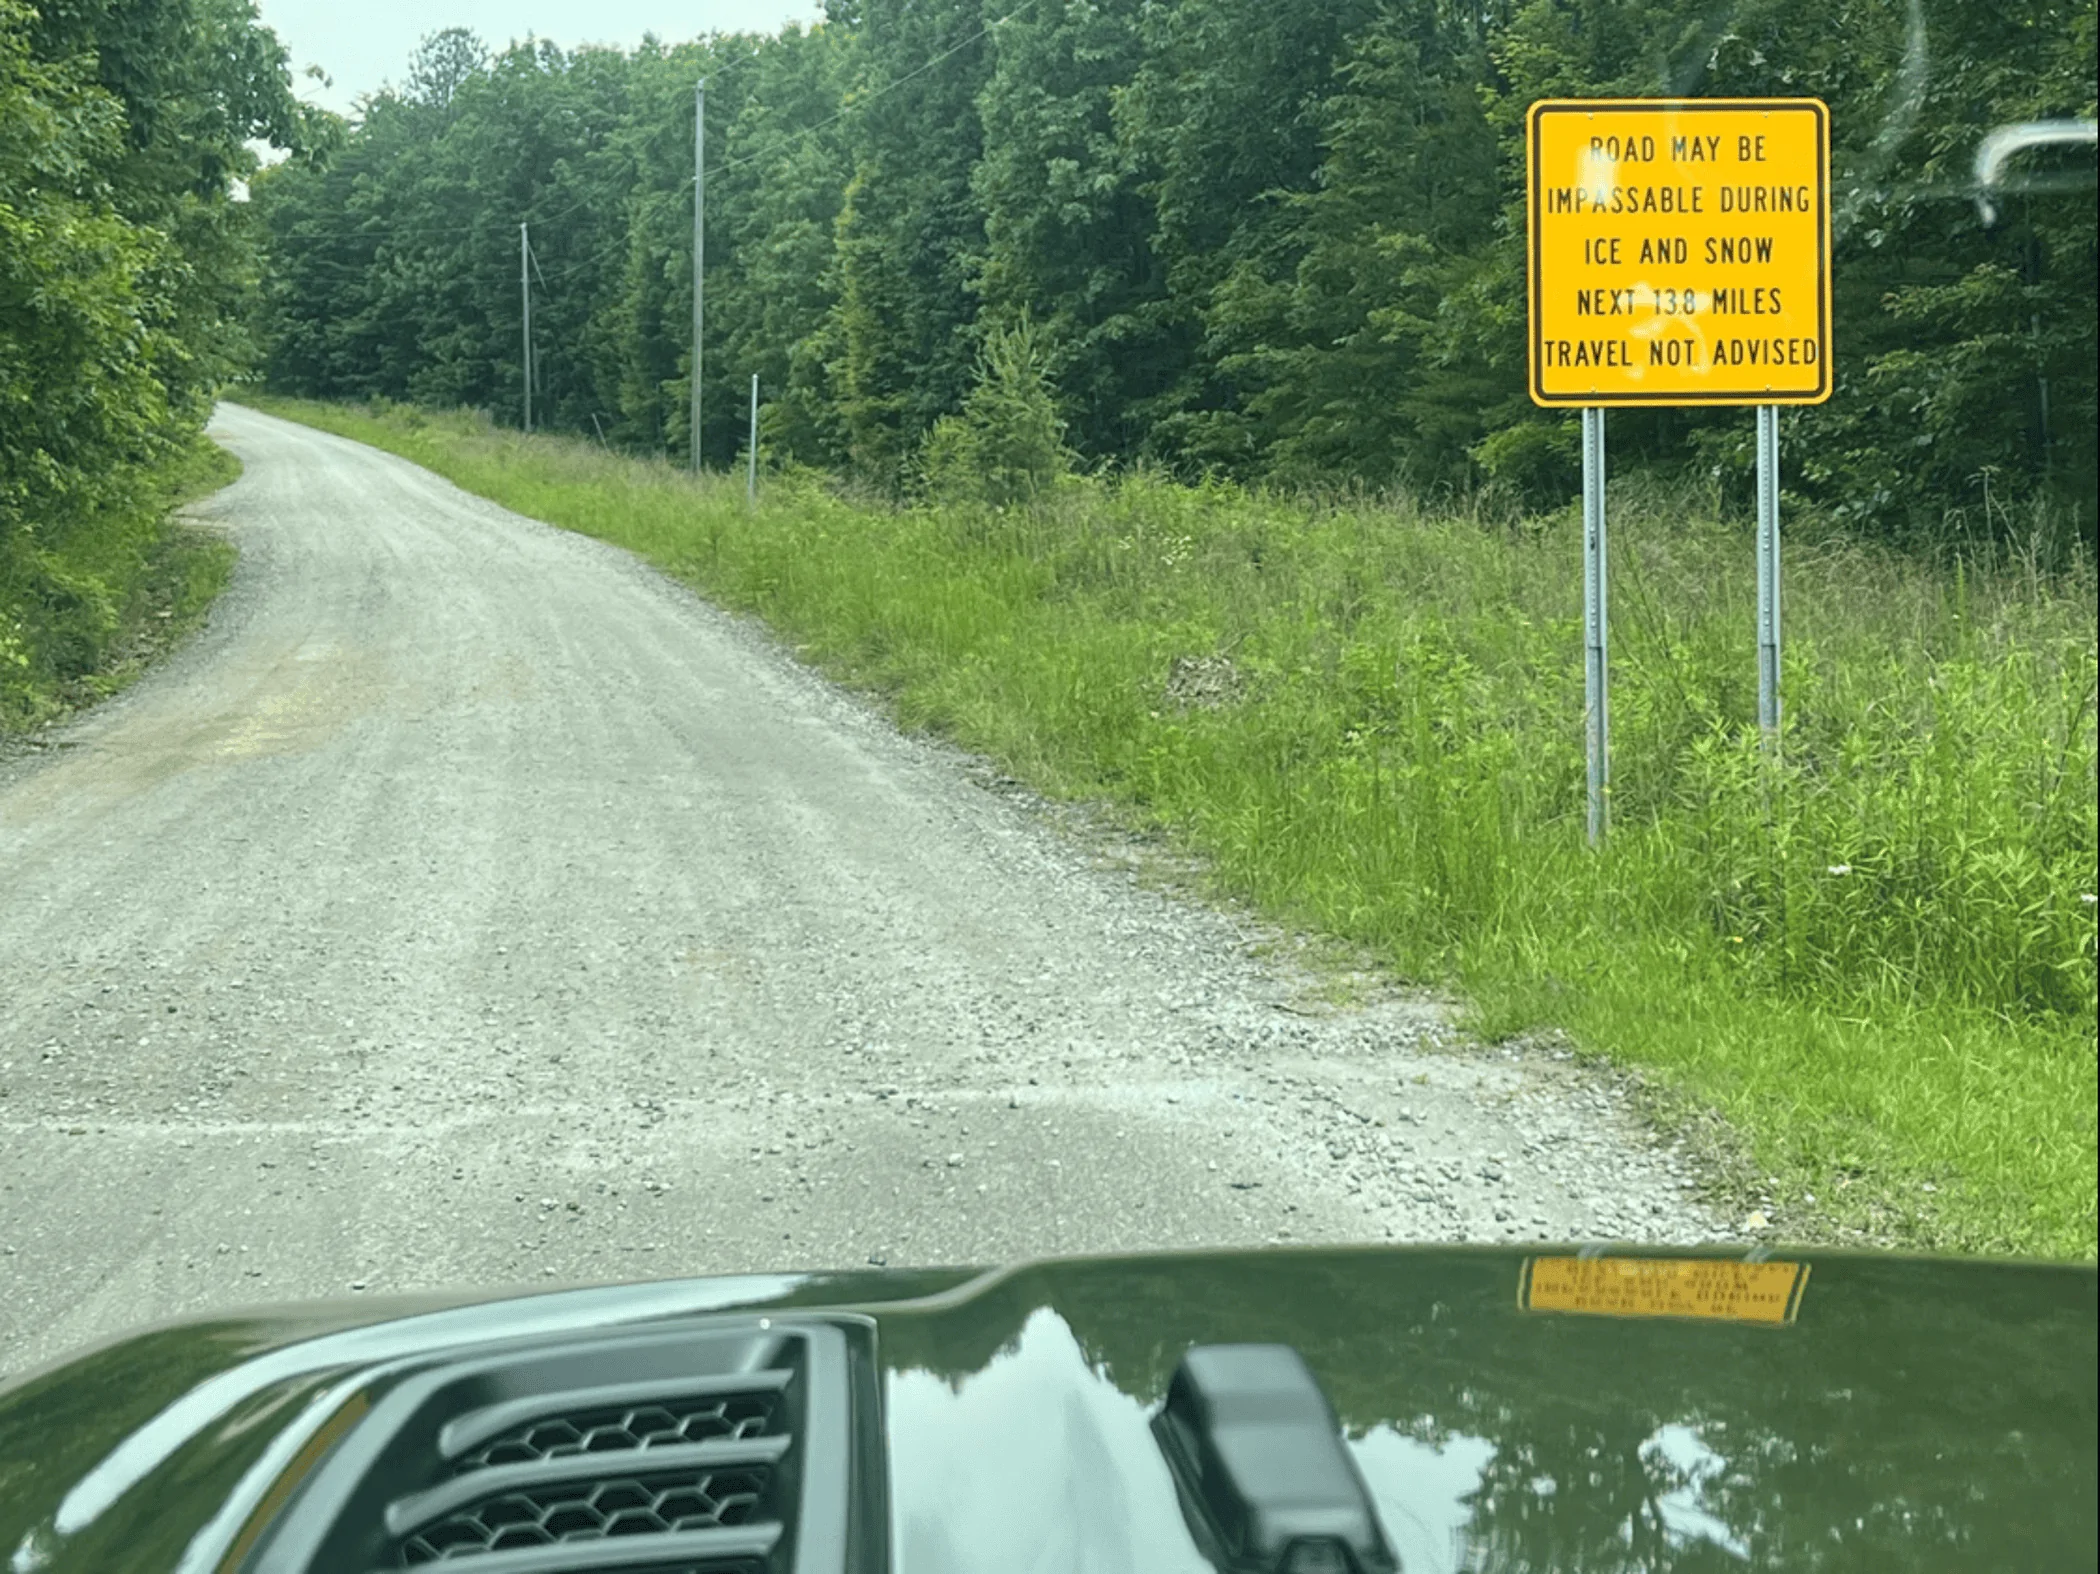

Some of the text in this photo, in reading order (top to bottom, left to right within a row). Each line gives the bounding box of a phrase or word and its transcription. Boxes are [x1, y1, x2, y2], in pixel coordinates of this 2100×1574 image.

[1590, 136, 1766, 163] ROAD MAY BE
[1548, 186, 1809, 214] IMPASSABLE DURING
[1585, 237, 1773, 265] ICE AND SNOW
[1577, 289, 1635, 316] NEXT
[1712, 288, 1782, 315] MILES
[1544, 339, 1817, 367] TRAVEL NOT ADVISED
